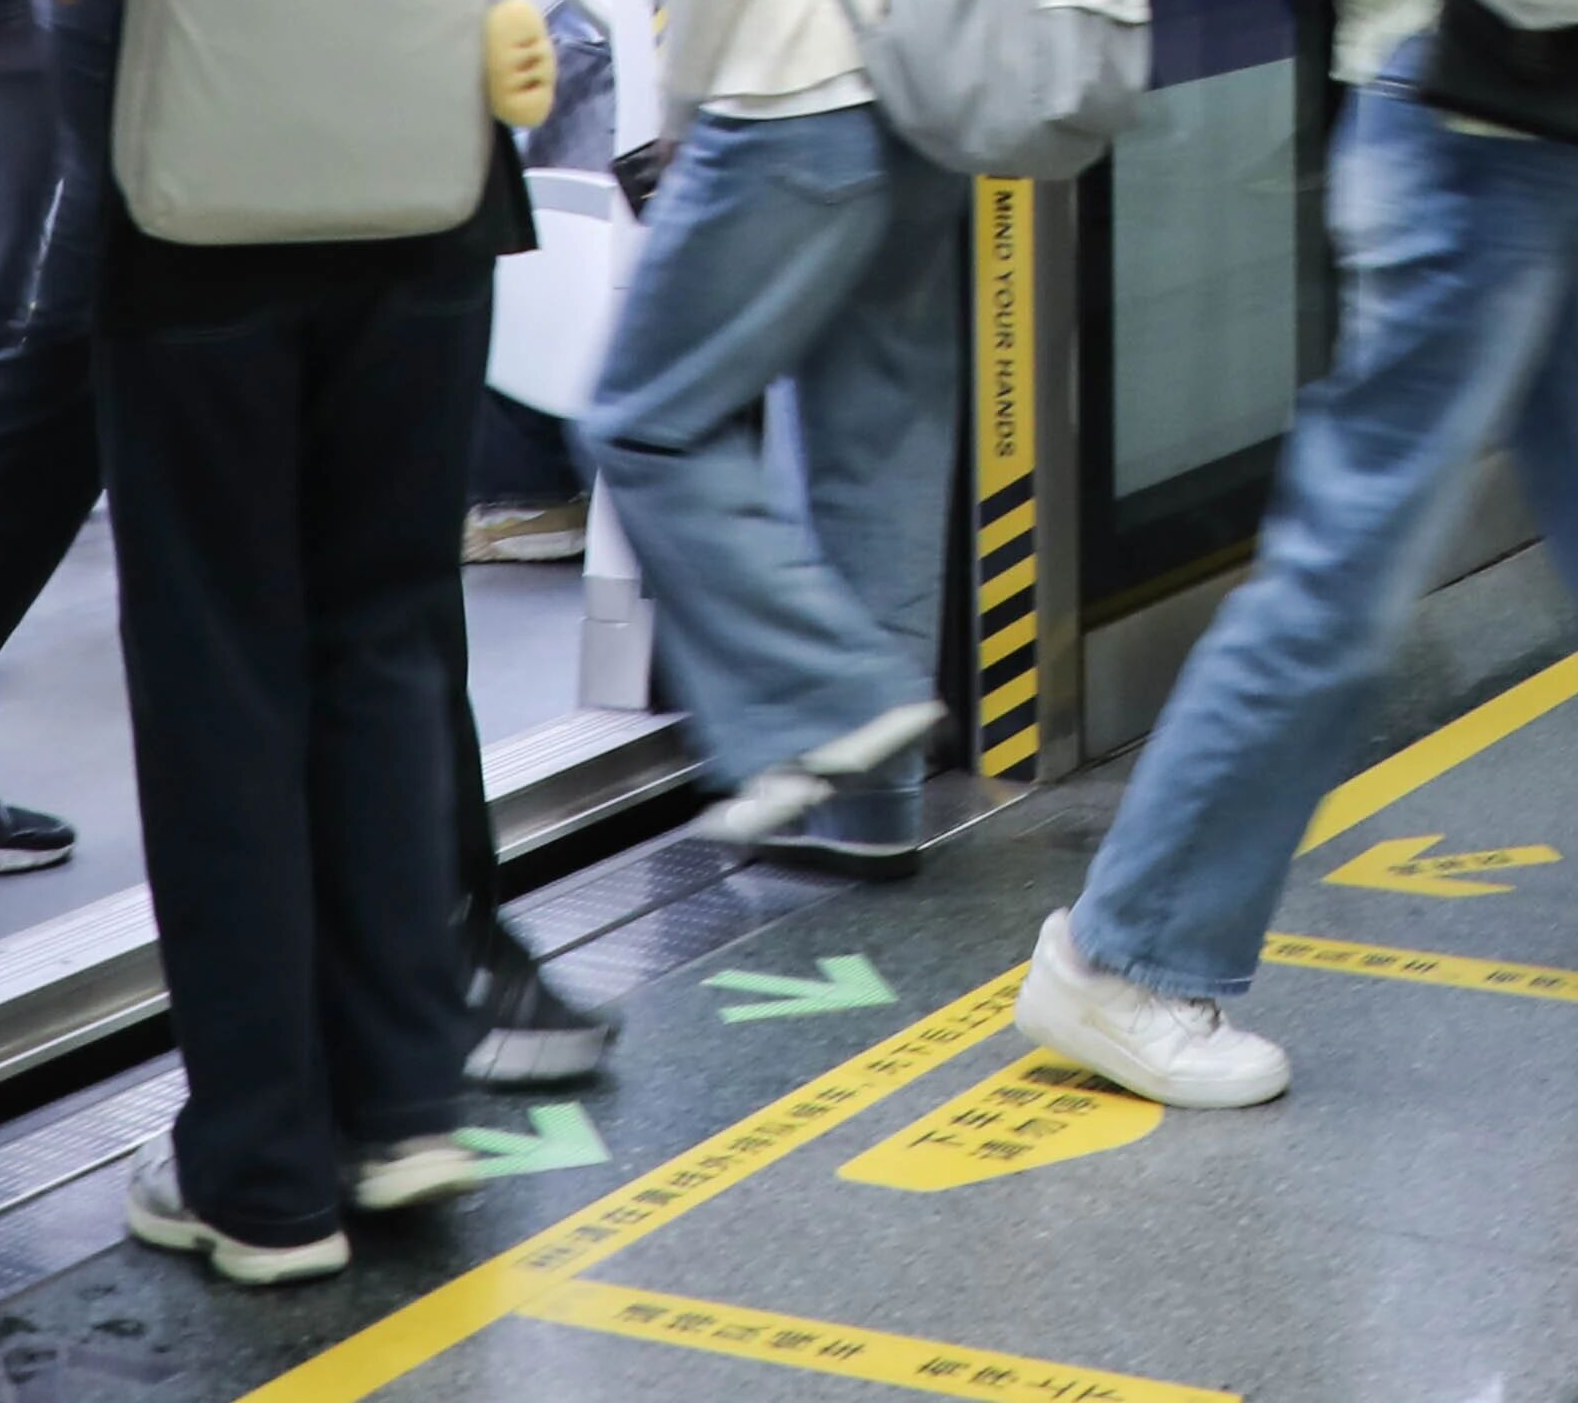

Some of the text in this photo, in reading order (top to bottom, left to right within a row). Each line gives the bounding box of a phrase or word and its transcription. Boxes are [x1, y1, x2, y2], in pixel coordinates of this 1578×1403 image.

[993, 189, 1018, 460] MIND YOUR HANDS
